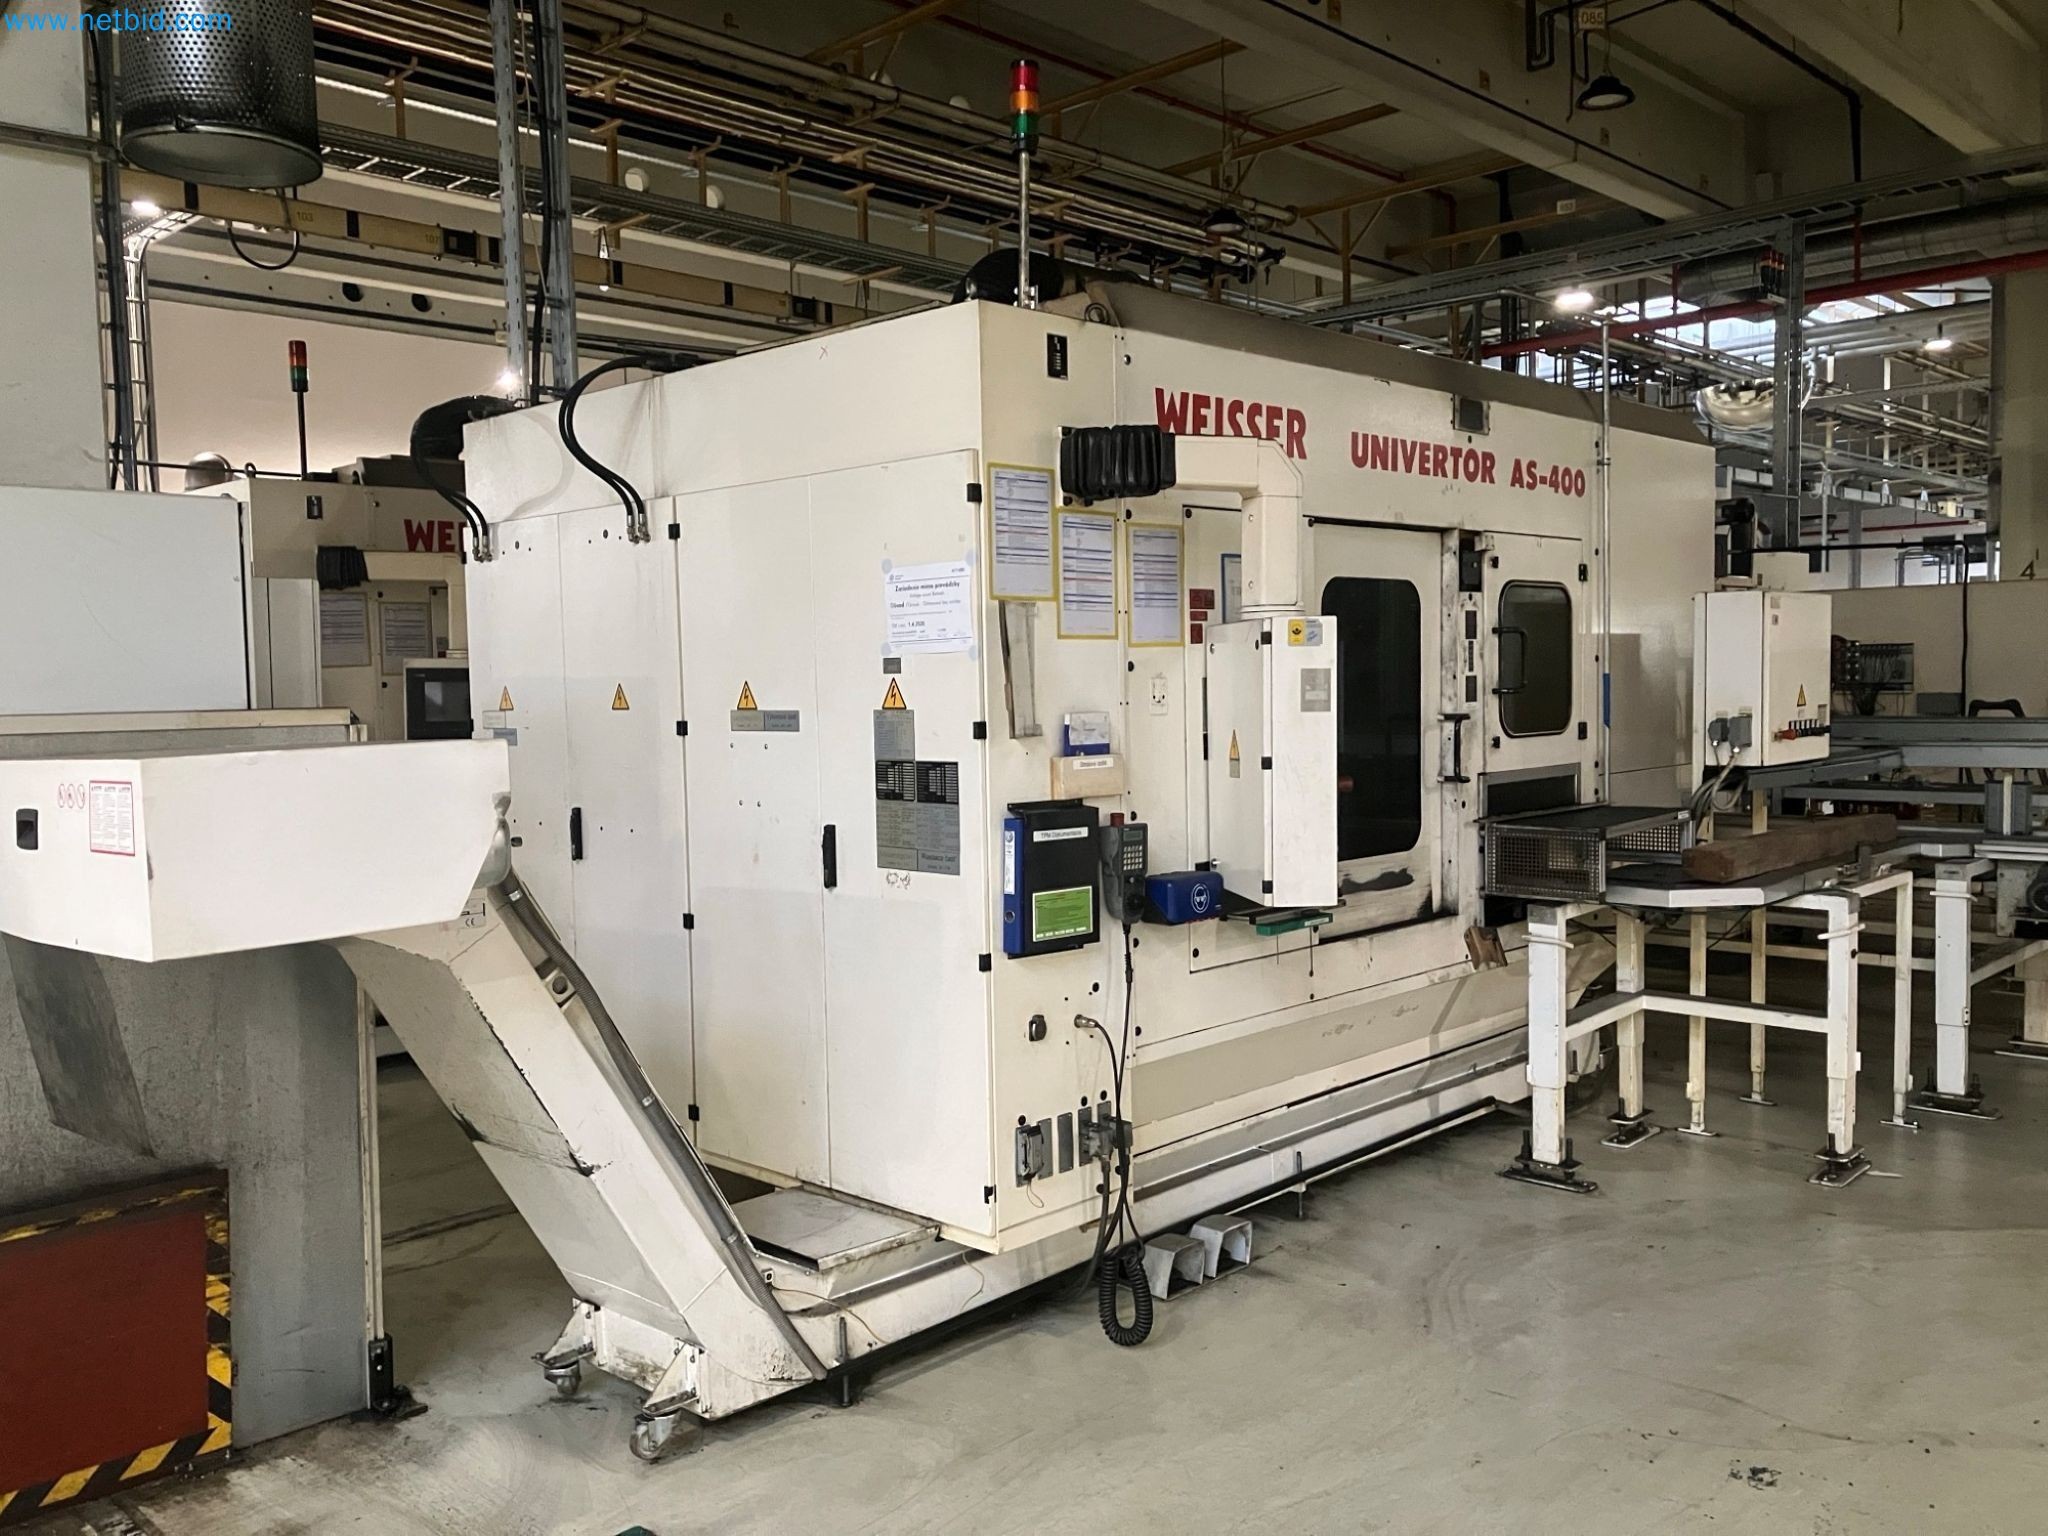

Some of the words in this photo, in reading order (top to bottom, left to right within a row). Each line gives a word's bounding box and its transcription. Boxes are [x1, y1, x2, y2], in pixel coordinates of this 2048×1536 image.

[1155, 387, 1308, 460] WEISSER
[1351, 431, 1496, 484] UNIVERTOR
[1510, 458, 1586, 498] AS-400
